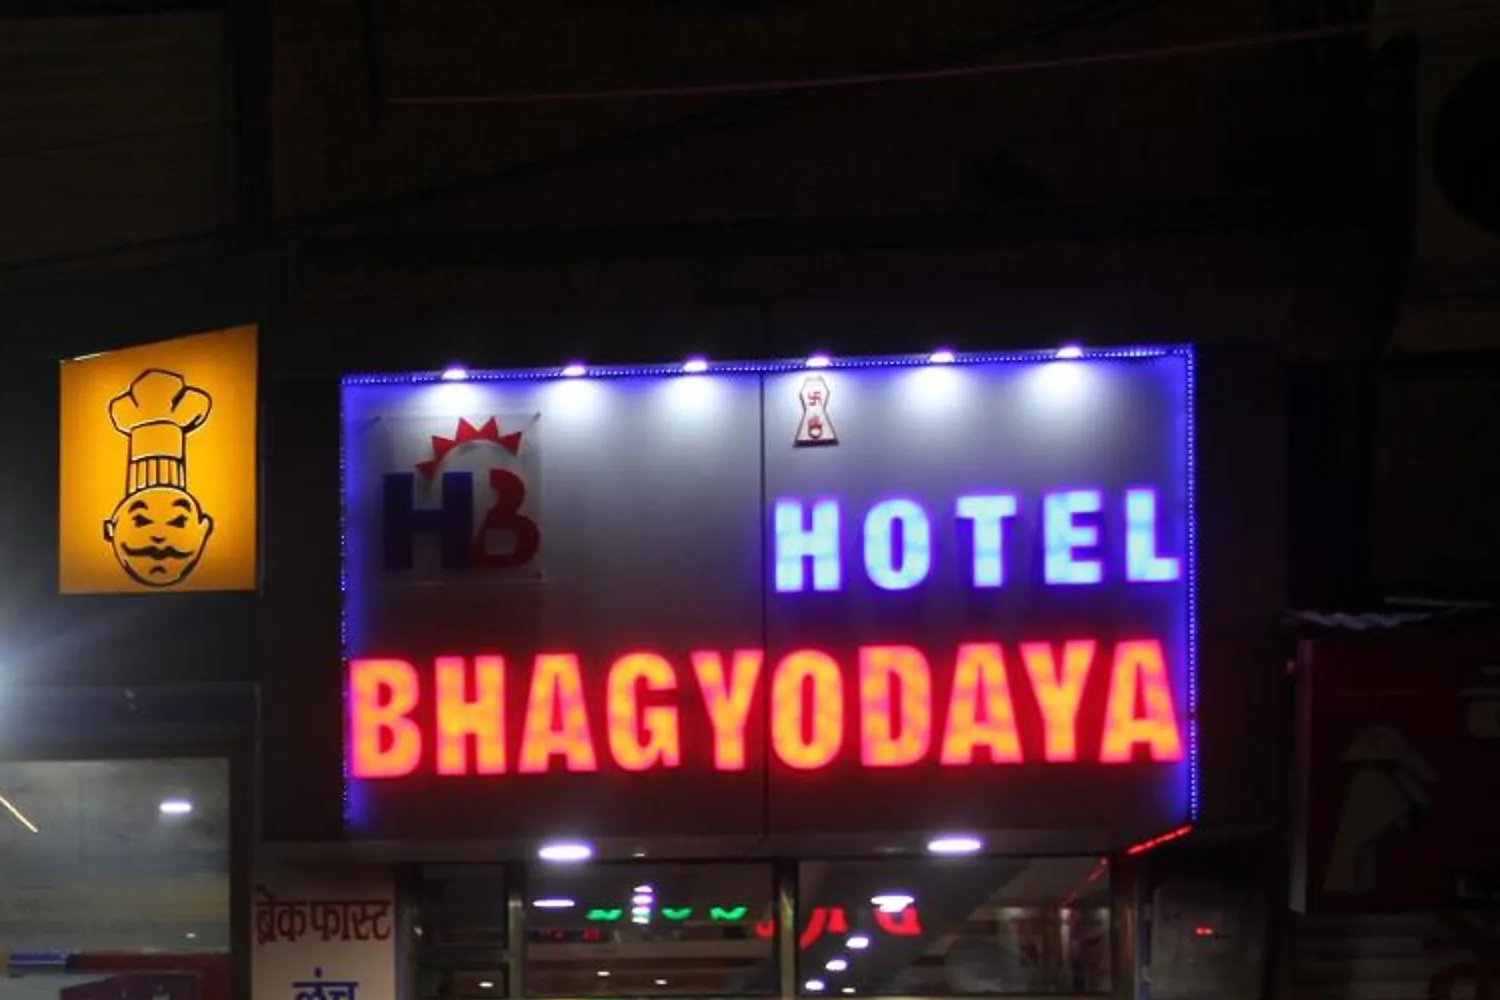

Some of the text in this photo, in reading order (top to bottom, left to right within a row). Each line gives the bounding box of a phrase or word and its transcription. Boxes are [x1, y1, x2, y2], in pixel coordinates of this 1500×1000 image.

[384, 468, 541, 574] HB
[774, 487, 1183, 594] HOTEL
[346, 637, 1186, 780] BHAGYODAYA
